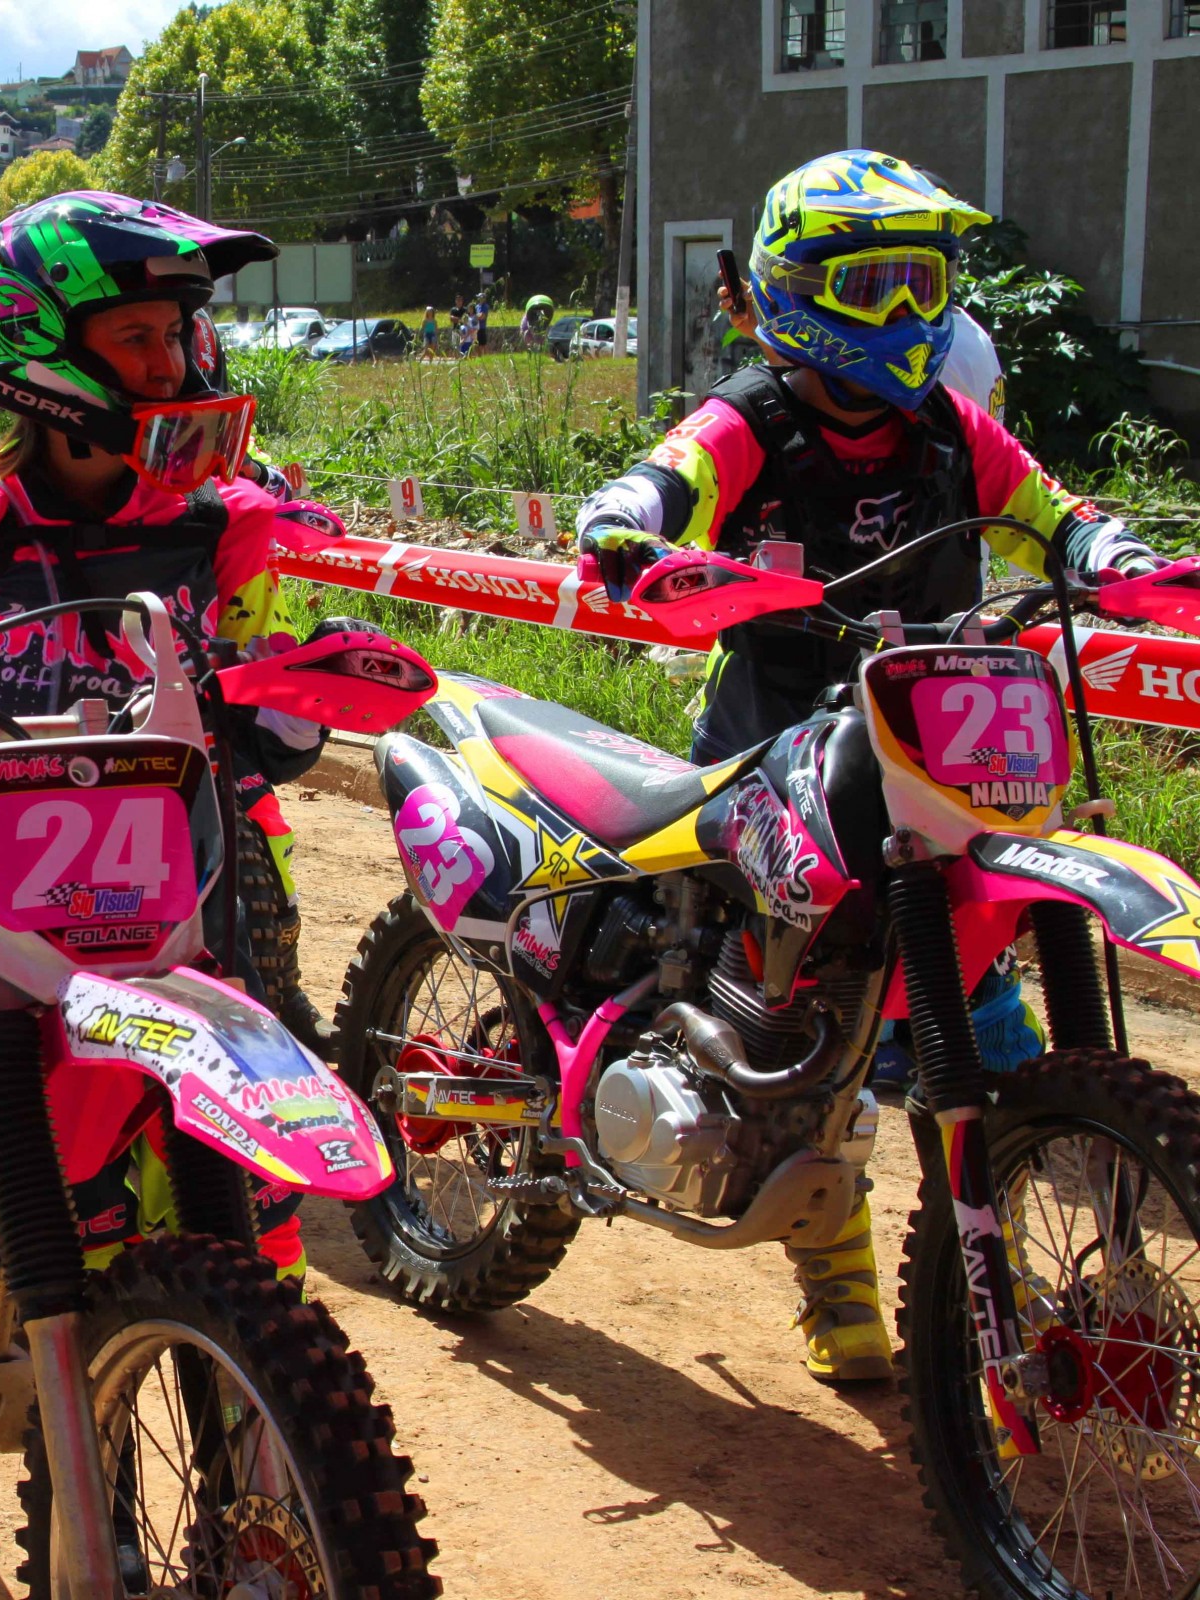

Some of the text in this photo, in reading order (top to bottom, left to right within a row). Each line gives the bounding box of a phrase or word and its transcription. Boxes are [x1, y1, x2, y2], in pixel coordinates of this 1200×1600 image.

[401, 477, 415, 508] 9
[528, 499, 543, 529] 8
[425, 566, 556, 606] HONDA
[68, 672, 140, 699] roa
[941, 682, 1053, 767] 23
[114, 756, 177, 771] AVTEC
[988, 753, 1039, 776] SigVisual
[971, 781, 1050, 807] NADIA
[12, 797, 170, 911] 24
[399, 803, 473, 906] 23
[69, 887, 144, 919] SigVisual
[66, 926, 159, 945] SOLANGE
[437, 1089, 476, 1105] AVTEC
[191, 1093, 260, 1158] HONDA
